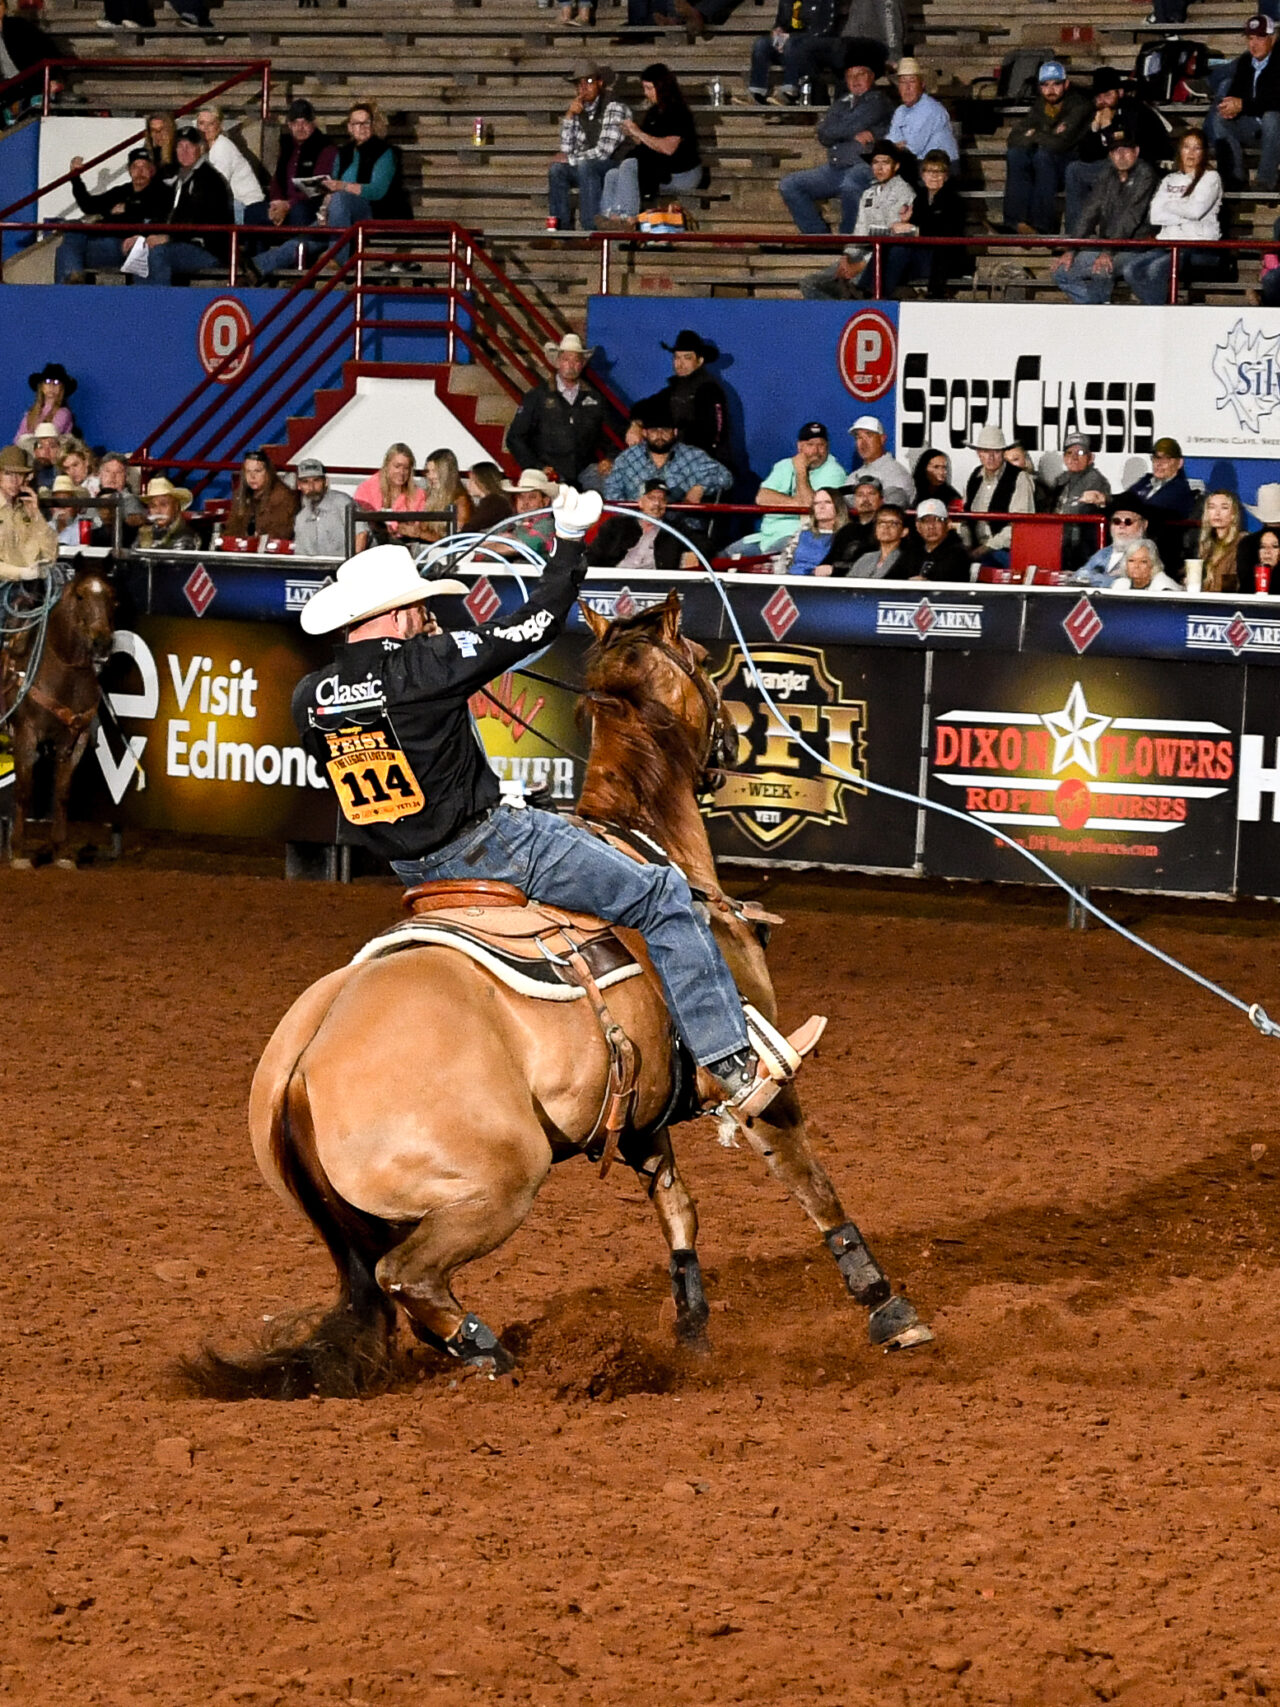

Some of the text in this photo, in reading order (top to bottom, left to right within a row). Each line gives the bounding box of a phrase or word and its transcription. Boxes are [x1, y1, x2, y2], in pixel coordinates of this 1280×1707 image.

[856, 330, 882, 371] P
[580, 598, 613, 615] AZY
[877, 609, 982, 629] LAZY ARENA
[1186, 623, 1225, 641] LAZY
[167, 654, 258, 718] Visit
[315, 672, 383, 706] Classic
[742, 667, 810, 699] Wrangler
[327, 731, 389, 757] FEIST
[934, 725, 1234, 780] DIXON FLOWERS
[345, 752, 368, 766] LEGACY
[340, 764, 416, 807] 114
[749, 782, 793, 799] WEEK
[754, 810, 781, 824] YETI
[966, 787, 1048, 814] ROPE
[1091, 793, 1187, 821] HORSES
